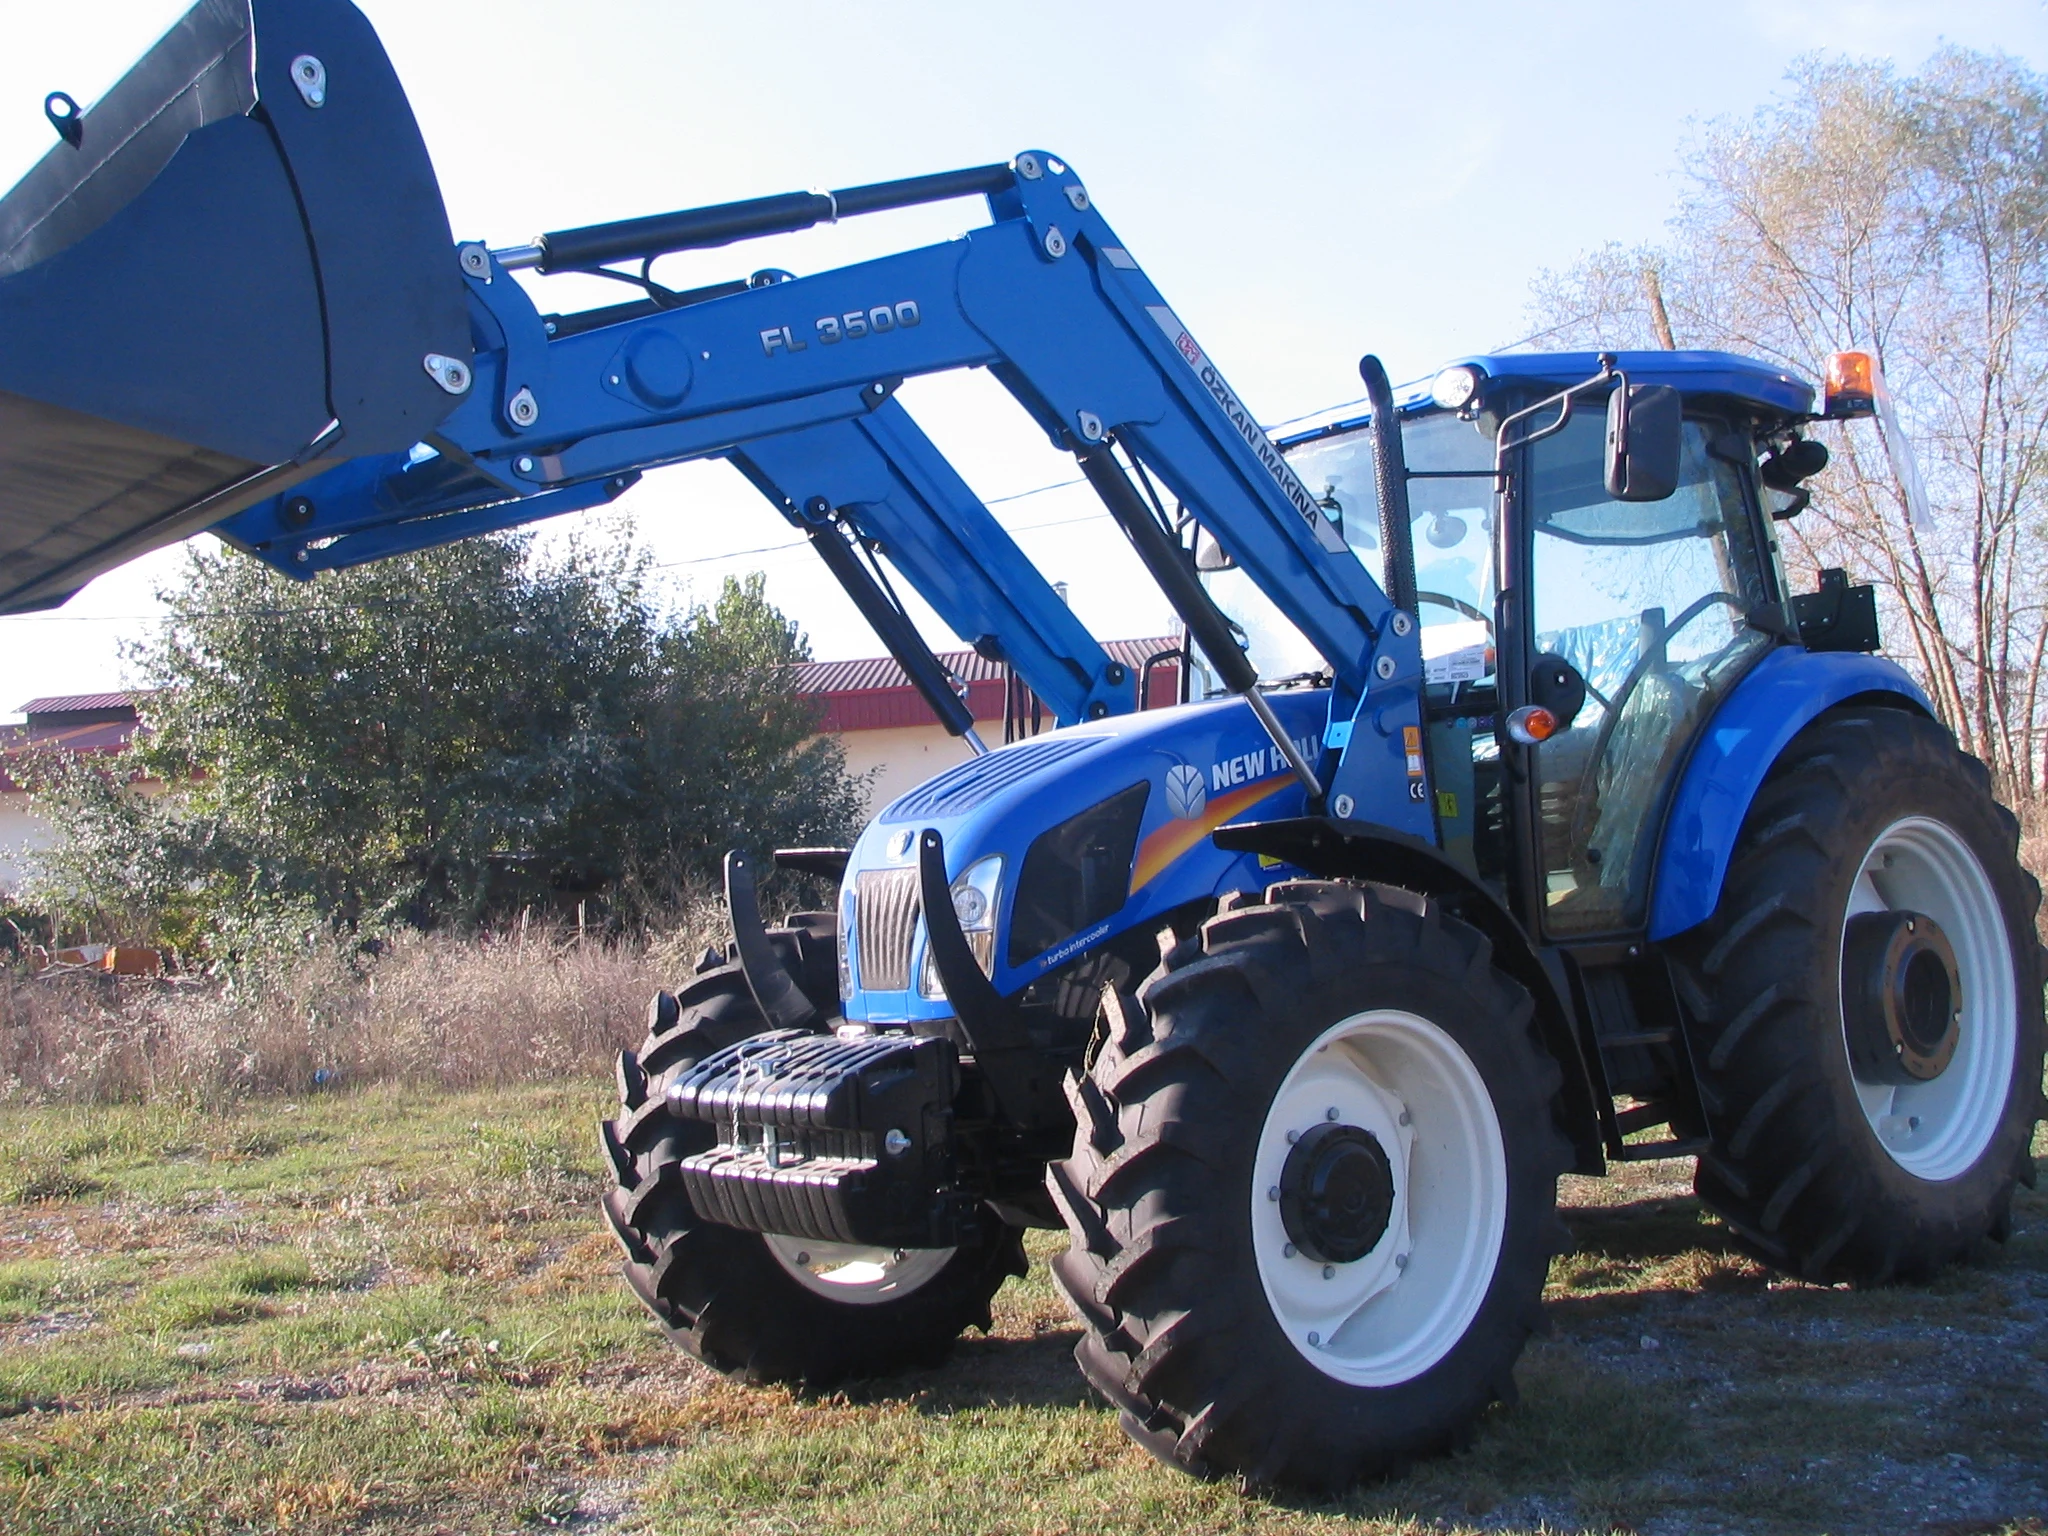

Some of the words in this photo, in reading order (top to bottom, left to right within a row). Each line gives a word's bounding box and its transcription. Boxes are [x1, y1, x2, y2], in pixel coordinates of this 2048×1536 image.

[760, 326, 807, 357] FL
[815, 300, 921, 345] 3500
[1200, 366, 1258, 445] ÖZKAN
[1212, 749, 1265, 791] NEW
[1409, 782, 1424, 799] CE
[1047, 947, 1069, 965] turbo
[1069, 924, 1109, 953] intercooler
